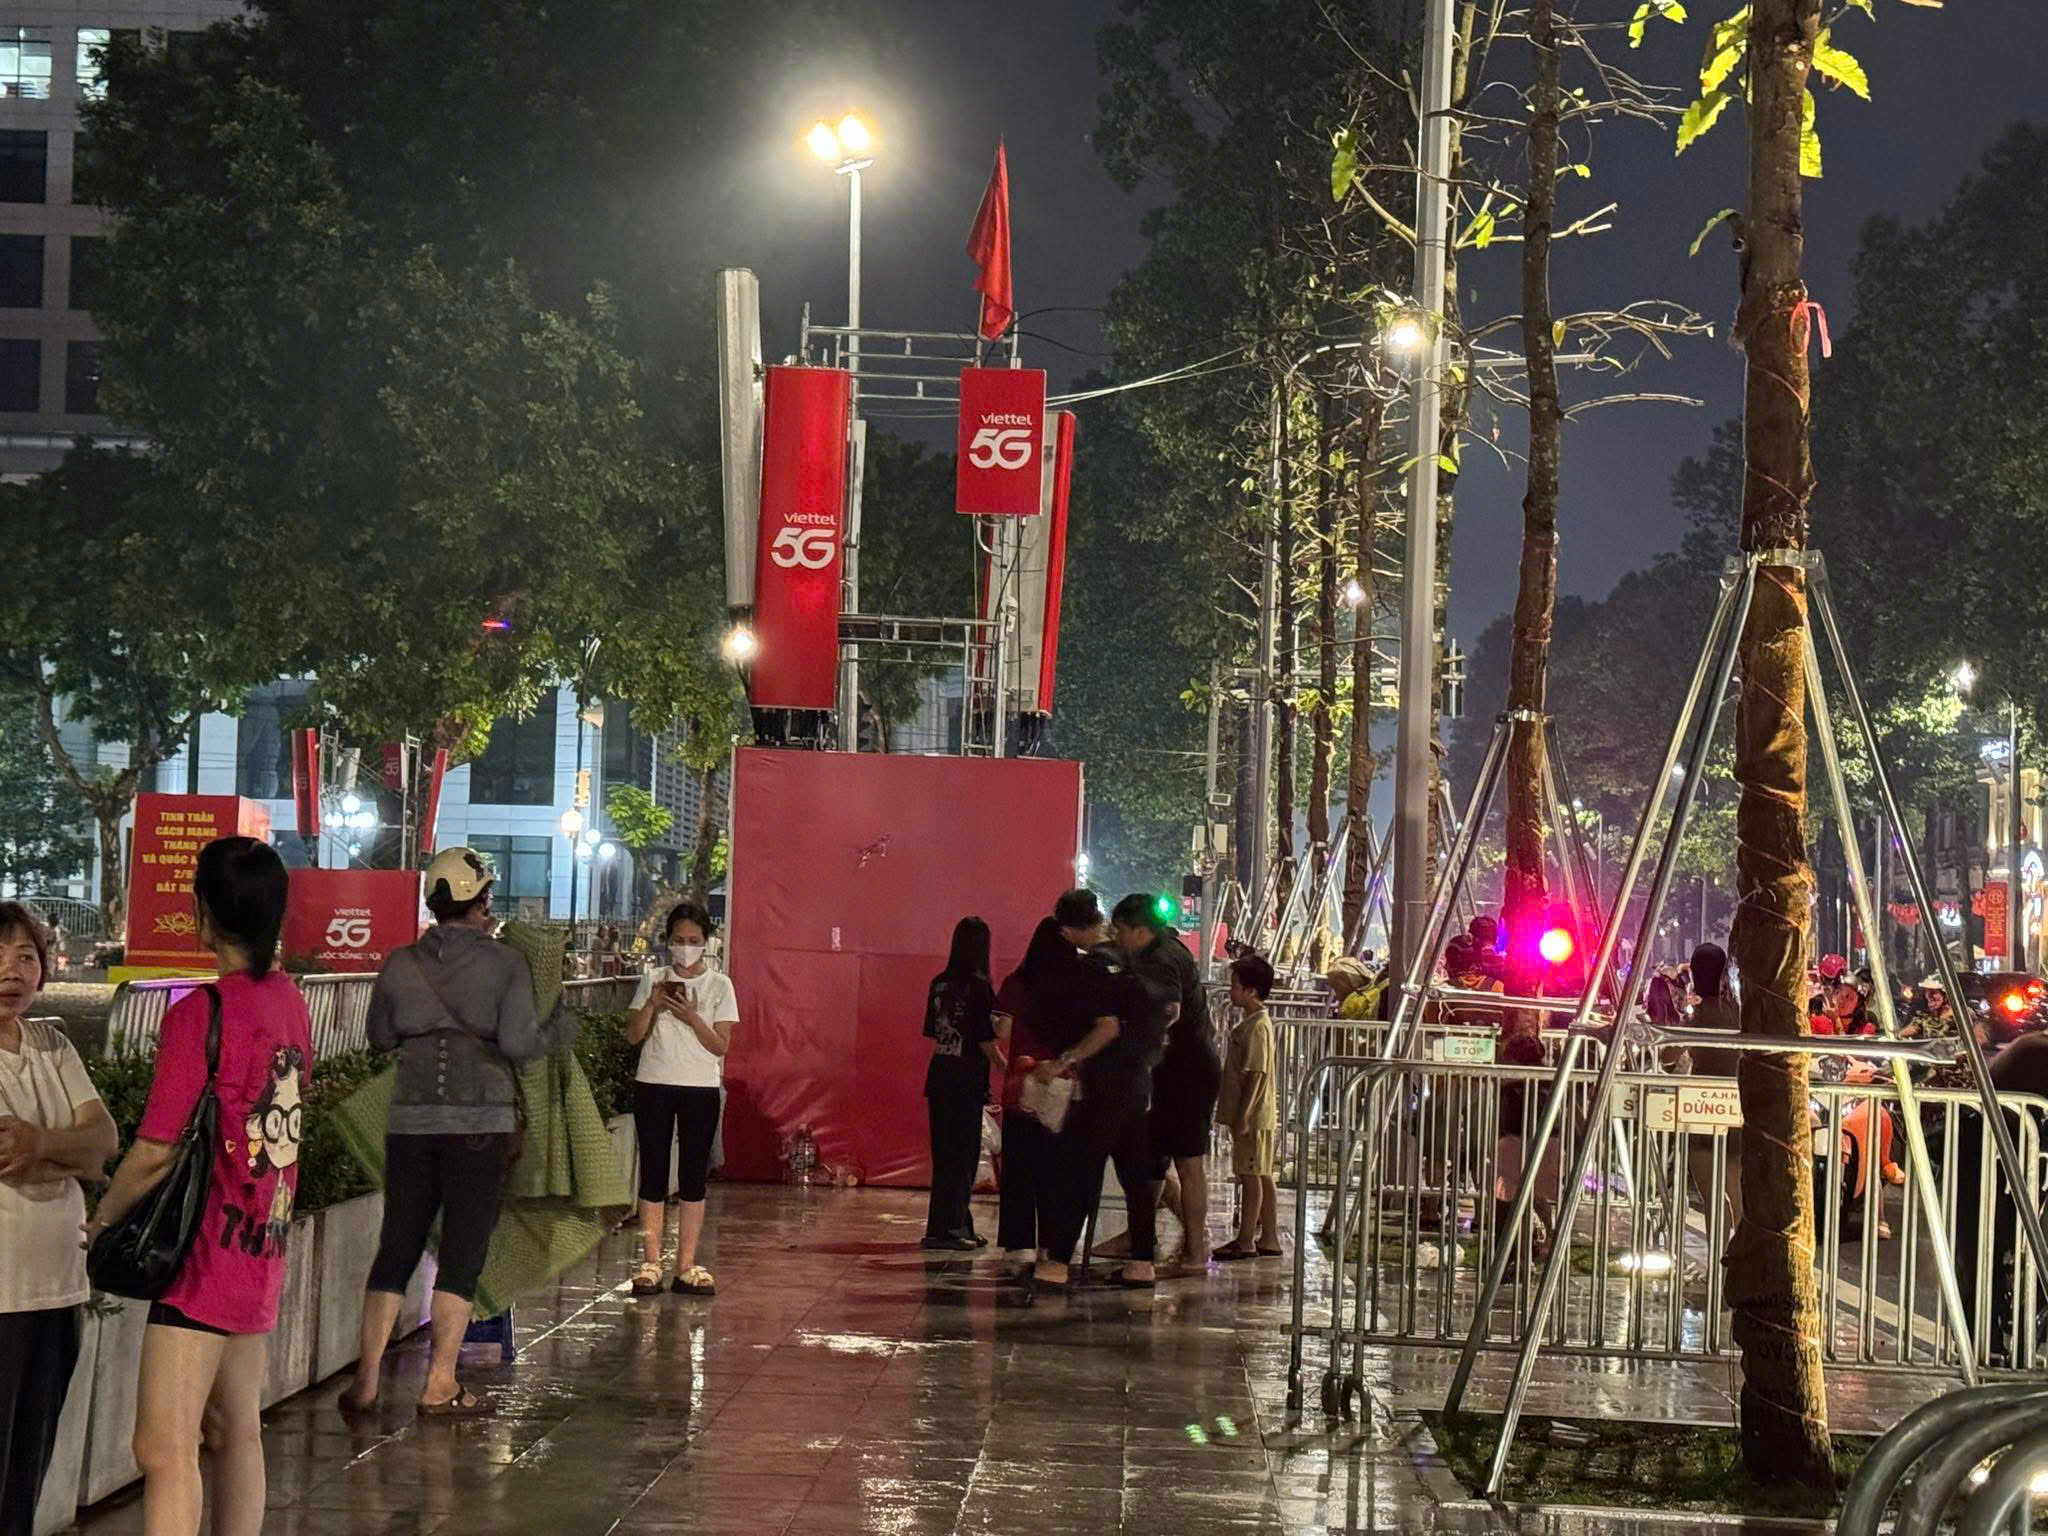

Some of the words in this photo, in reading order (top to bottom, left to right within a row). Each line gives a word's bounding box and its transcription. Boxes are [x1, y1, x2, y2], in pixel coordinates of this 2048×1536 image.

[980, 412, 1033, 426] viettel
[968, 428, 1033, 470] 5G
[783, 512, 837, 526] viettel
[770, 527, 836, 570] 5G
[334, 907, 372, 916] viettel
[325, 918, 372, 948] 5G
[1454, 1046, 1485, 1056] STOP
[1683, 1098, 1727, 1116] DỪNG
